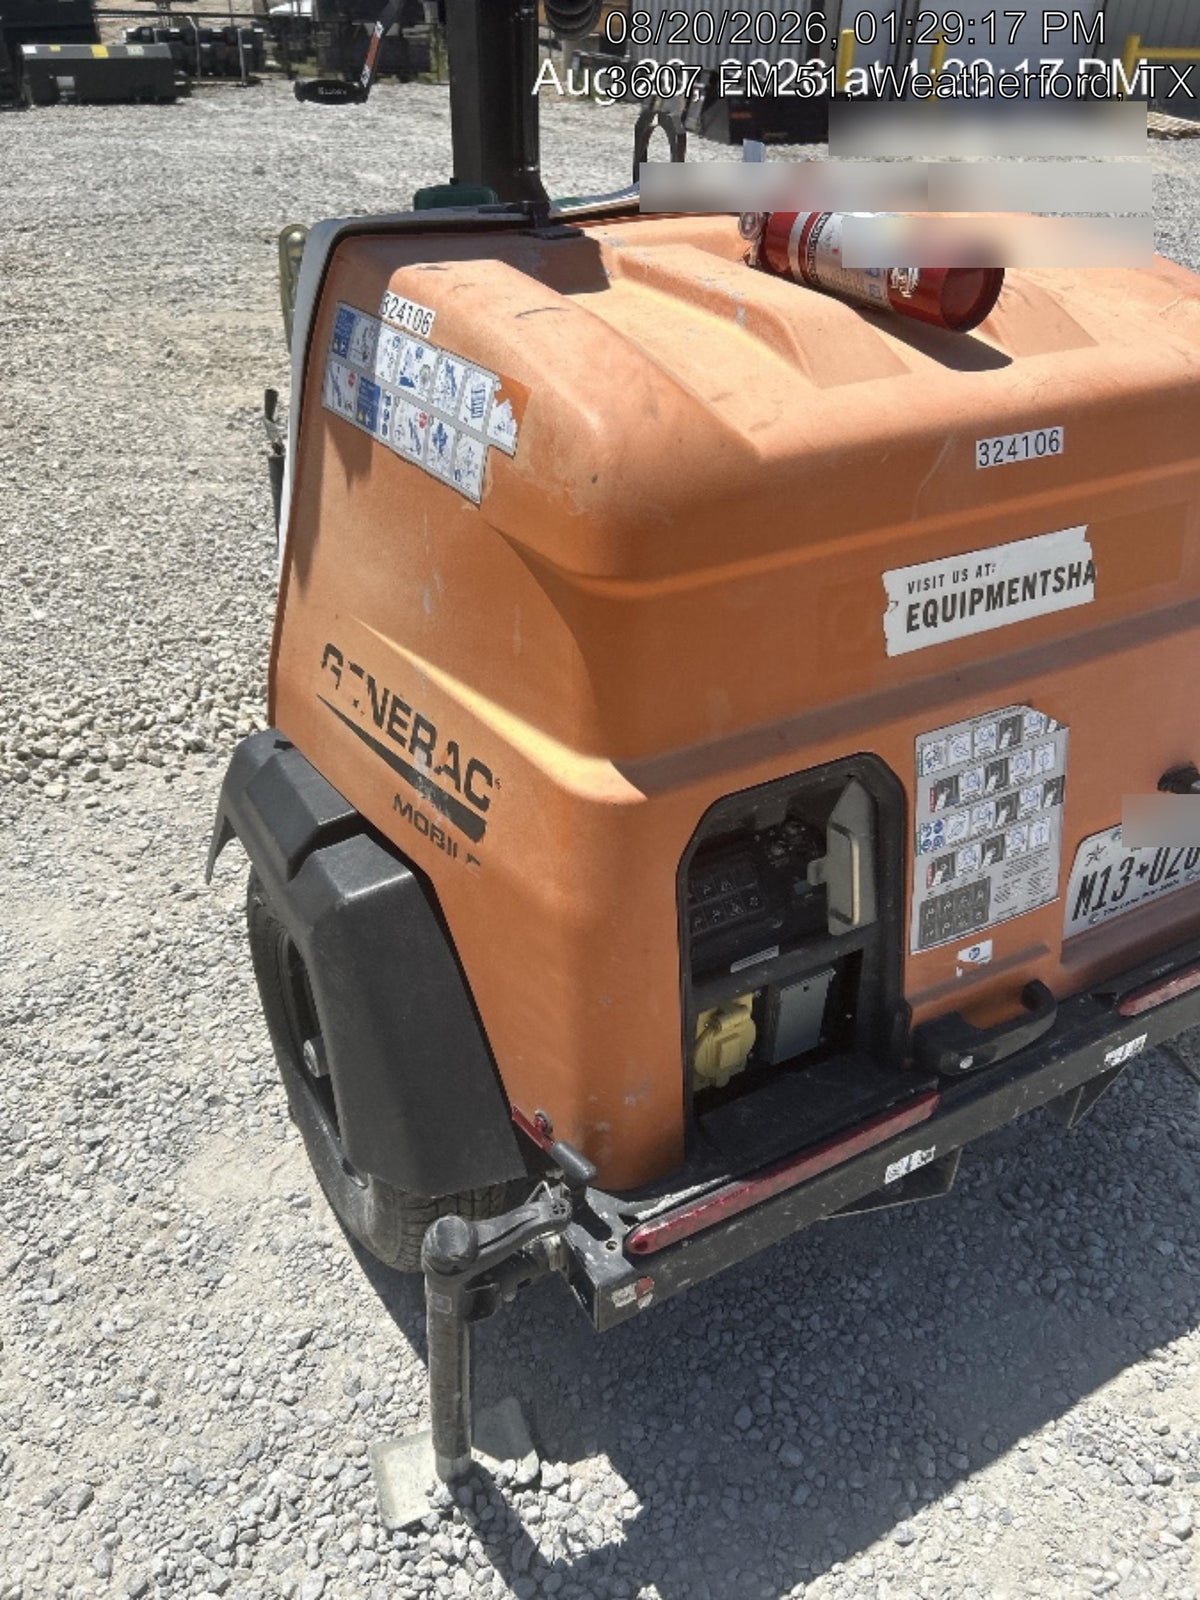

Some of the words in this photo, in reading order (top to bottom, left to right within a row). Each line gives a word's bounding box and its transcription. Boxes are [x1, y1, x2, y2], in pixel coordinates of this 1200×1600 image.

[380, 291, 433, 336] 324106
[977, 429, 1061, 467] 324106
[906, 559, 1096, 633] EQUIPMENTSHA
[907, 573, 945, 594] VISIT
[952, 567, 968, 583] US
[975, 562, 996, 579] AT:
[320, 642, 493, 813] GNERAC
